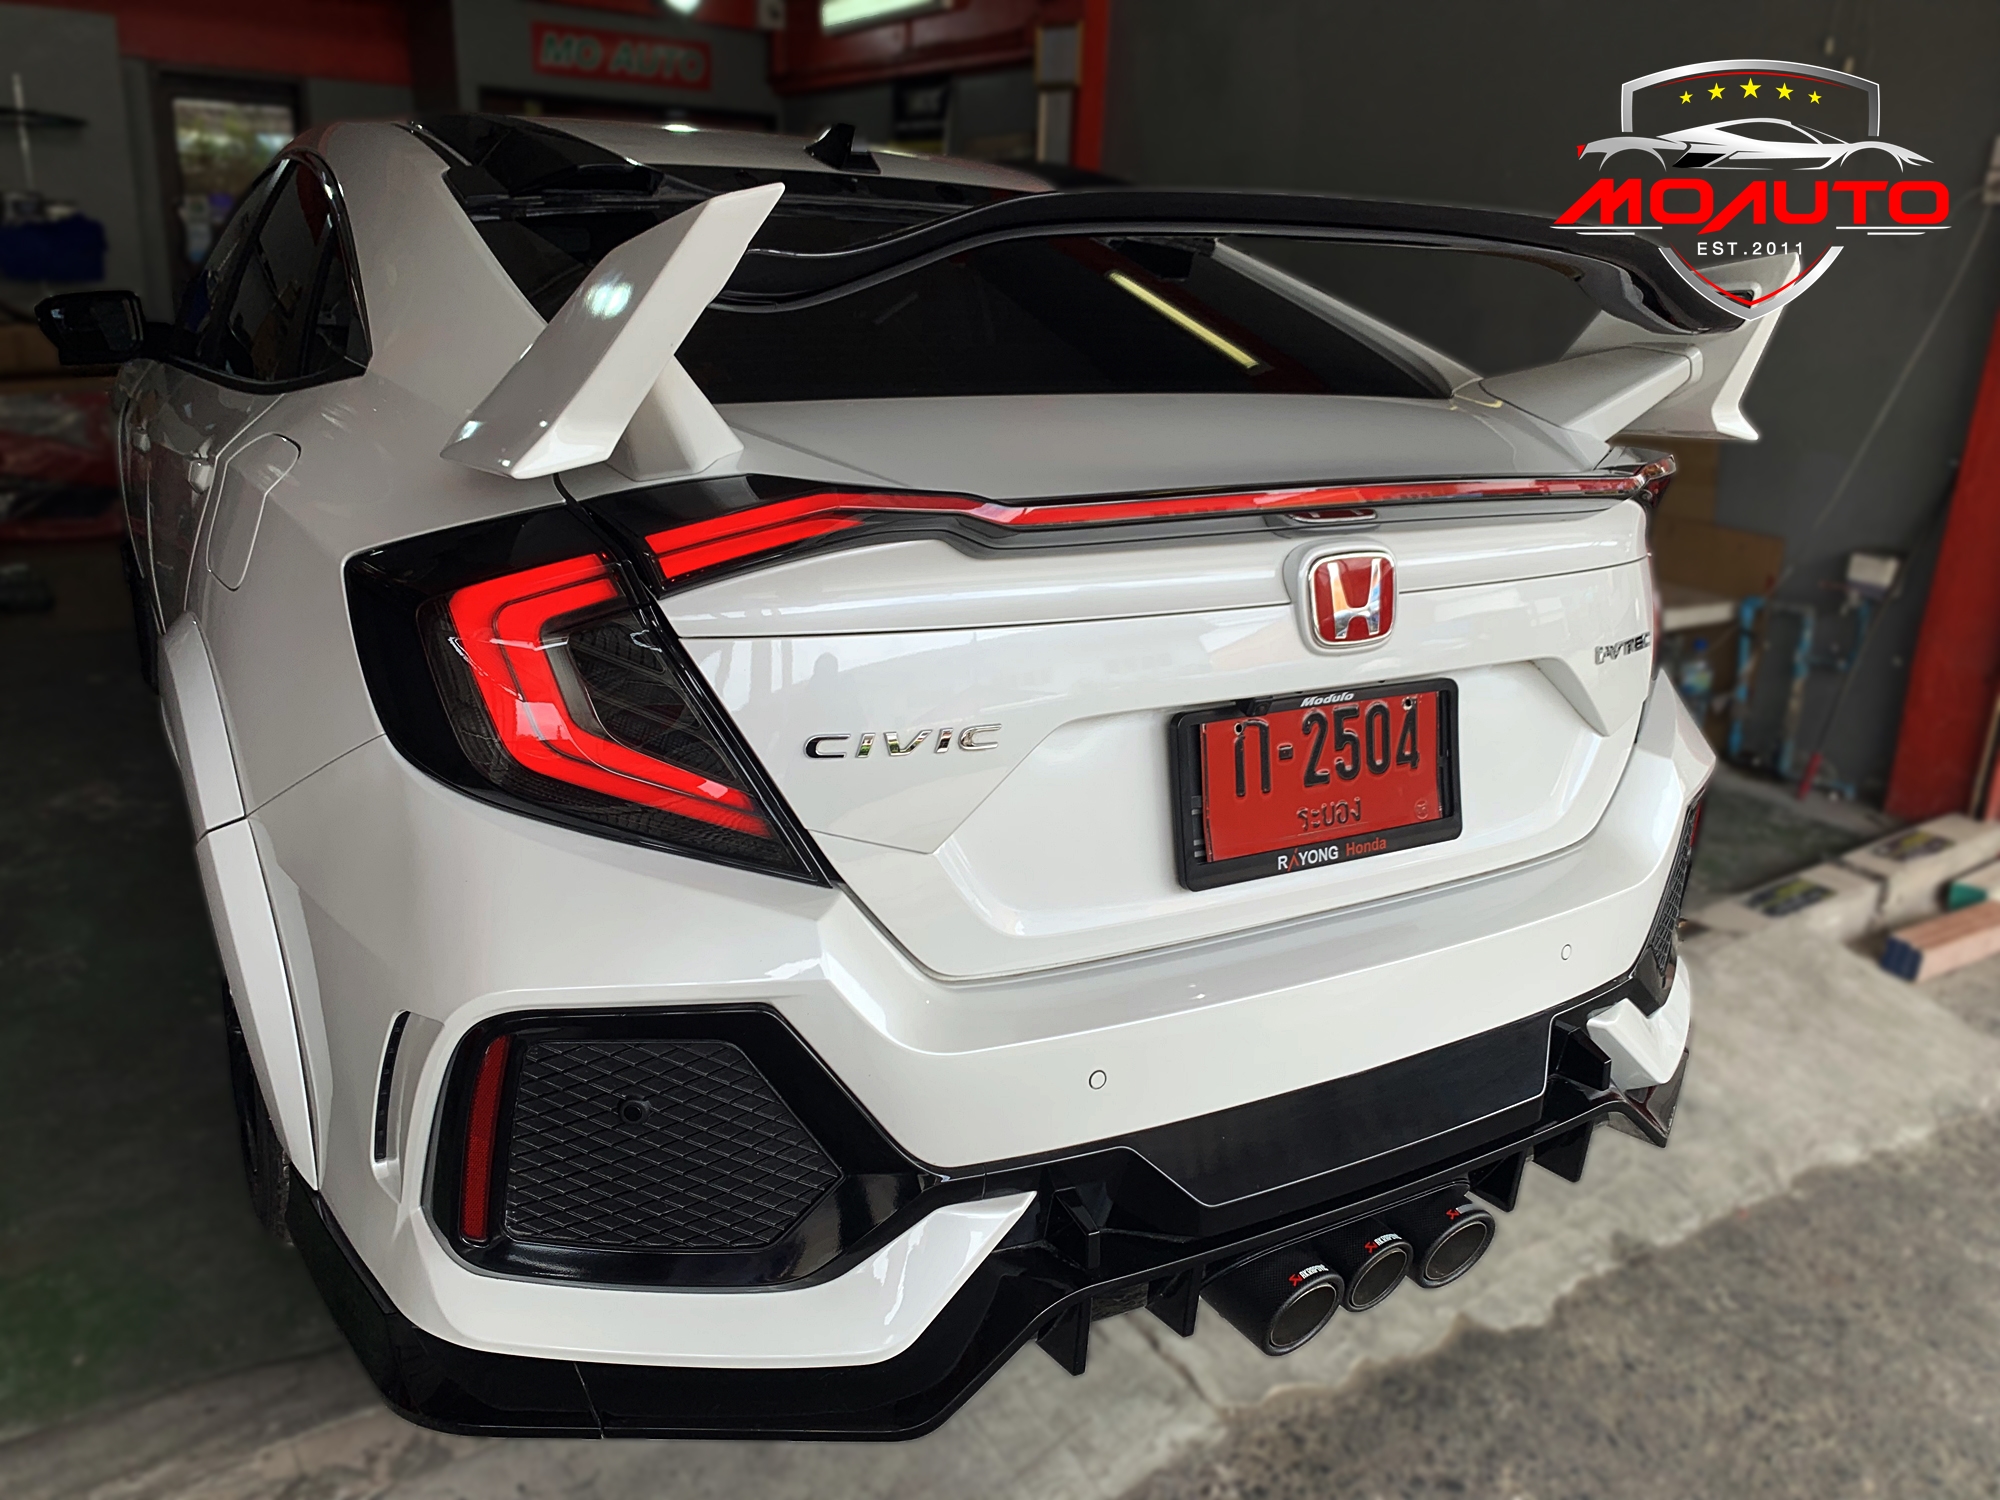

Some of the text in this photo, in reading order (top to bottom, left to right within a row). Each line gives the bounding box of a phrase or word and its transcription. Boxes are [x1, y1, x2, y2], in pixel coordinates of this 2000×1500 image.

[542, 33, 704, 82] MO AUTO
[1300, 692, 1354, 707] Modulo
[804, 724, 1002, 758] CIVIC
[1277, 838, 1387, 872] RAYONG Honda
